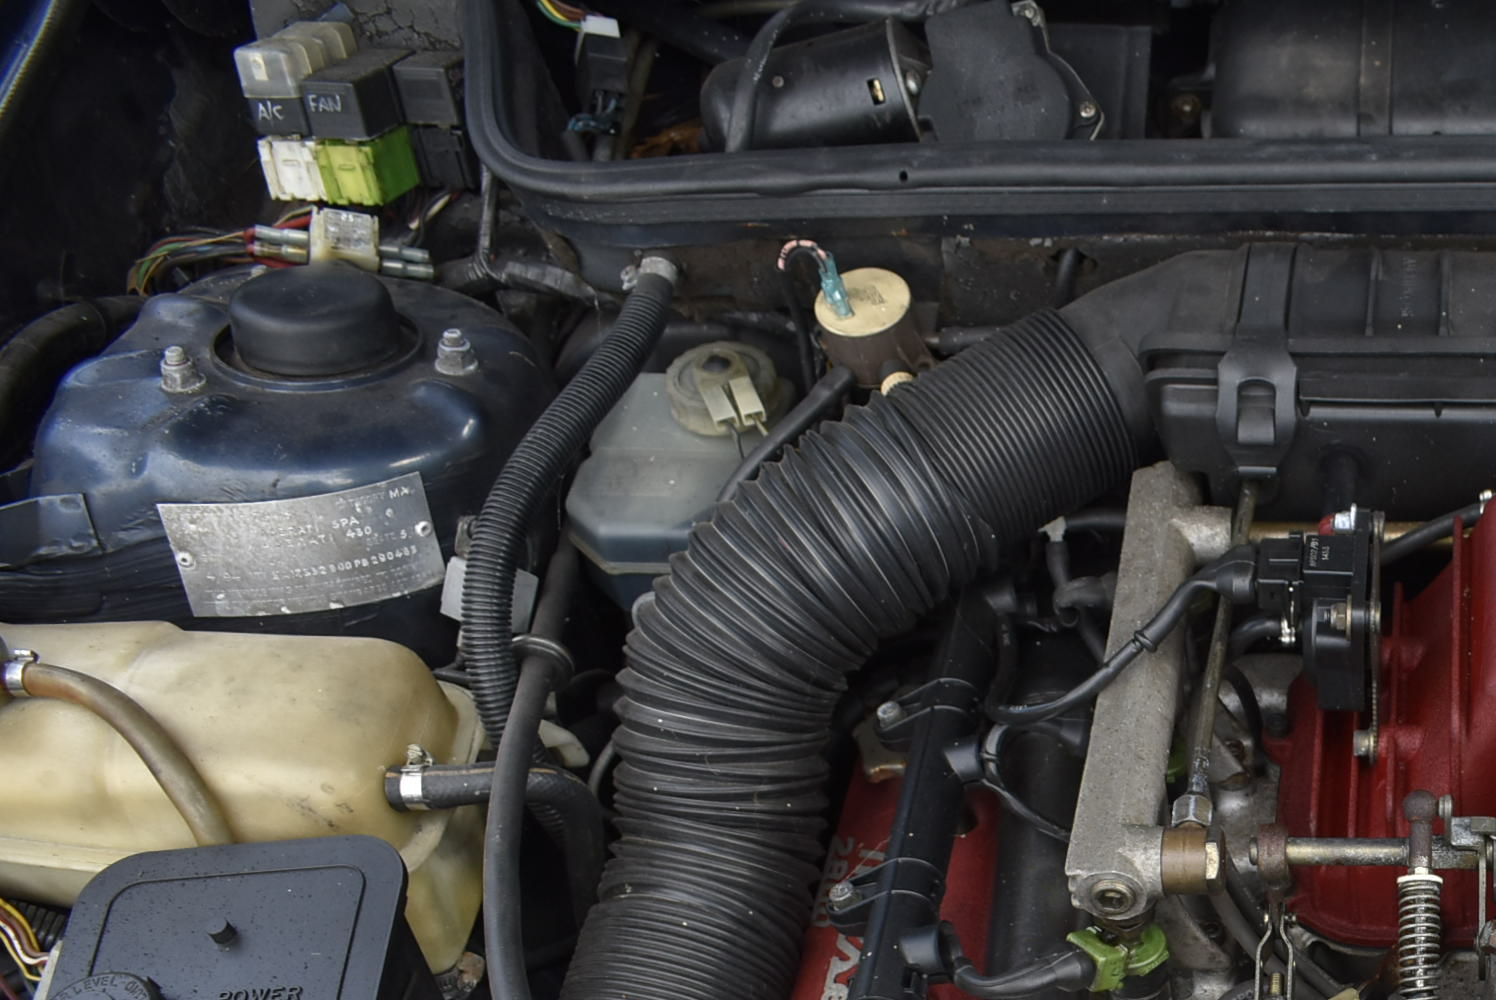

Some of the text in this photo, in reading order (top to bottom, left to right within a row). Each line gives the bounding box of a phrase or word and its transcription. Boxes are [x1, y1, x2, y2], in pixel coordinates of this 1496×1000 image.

[257, 100, 284, 121] A/C
[307, 93, 341, 113] FAN
[345, 525, 373, 539] 430
[73, 975, 119, 995] LEVEL
